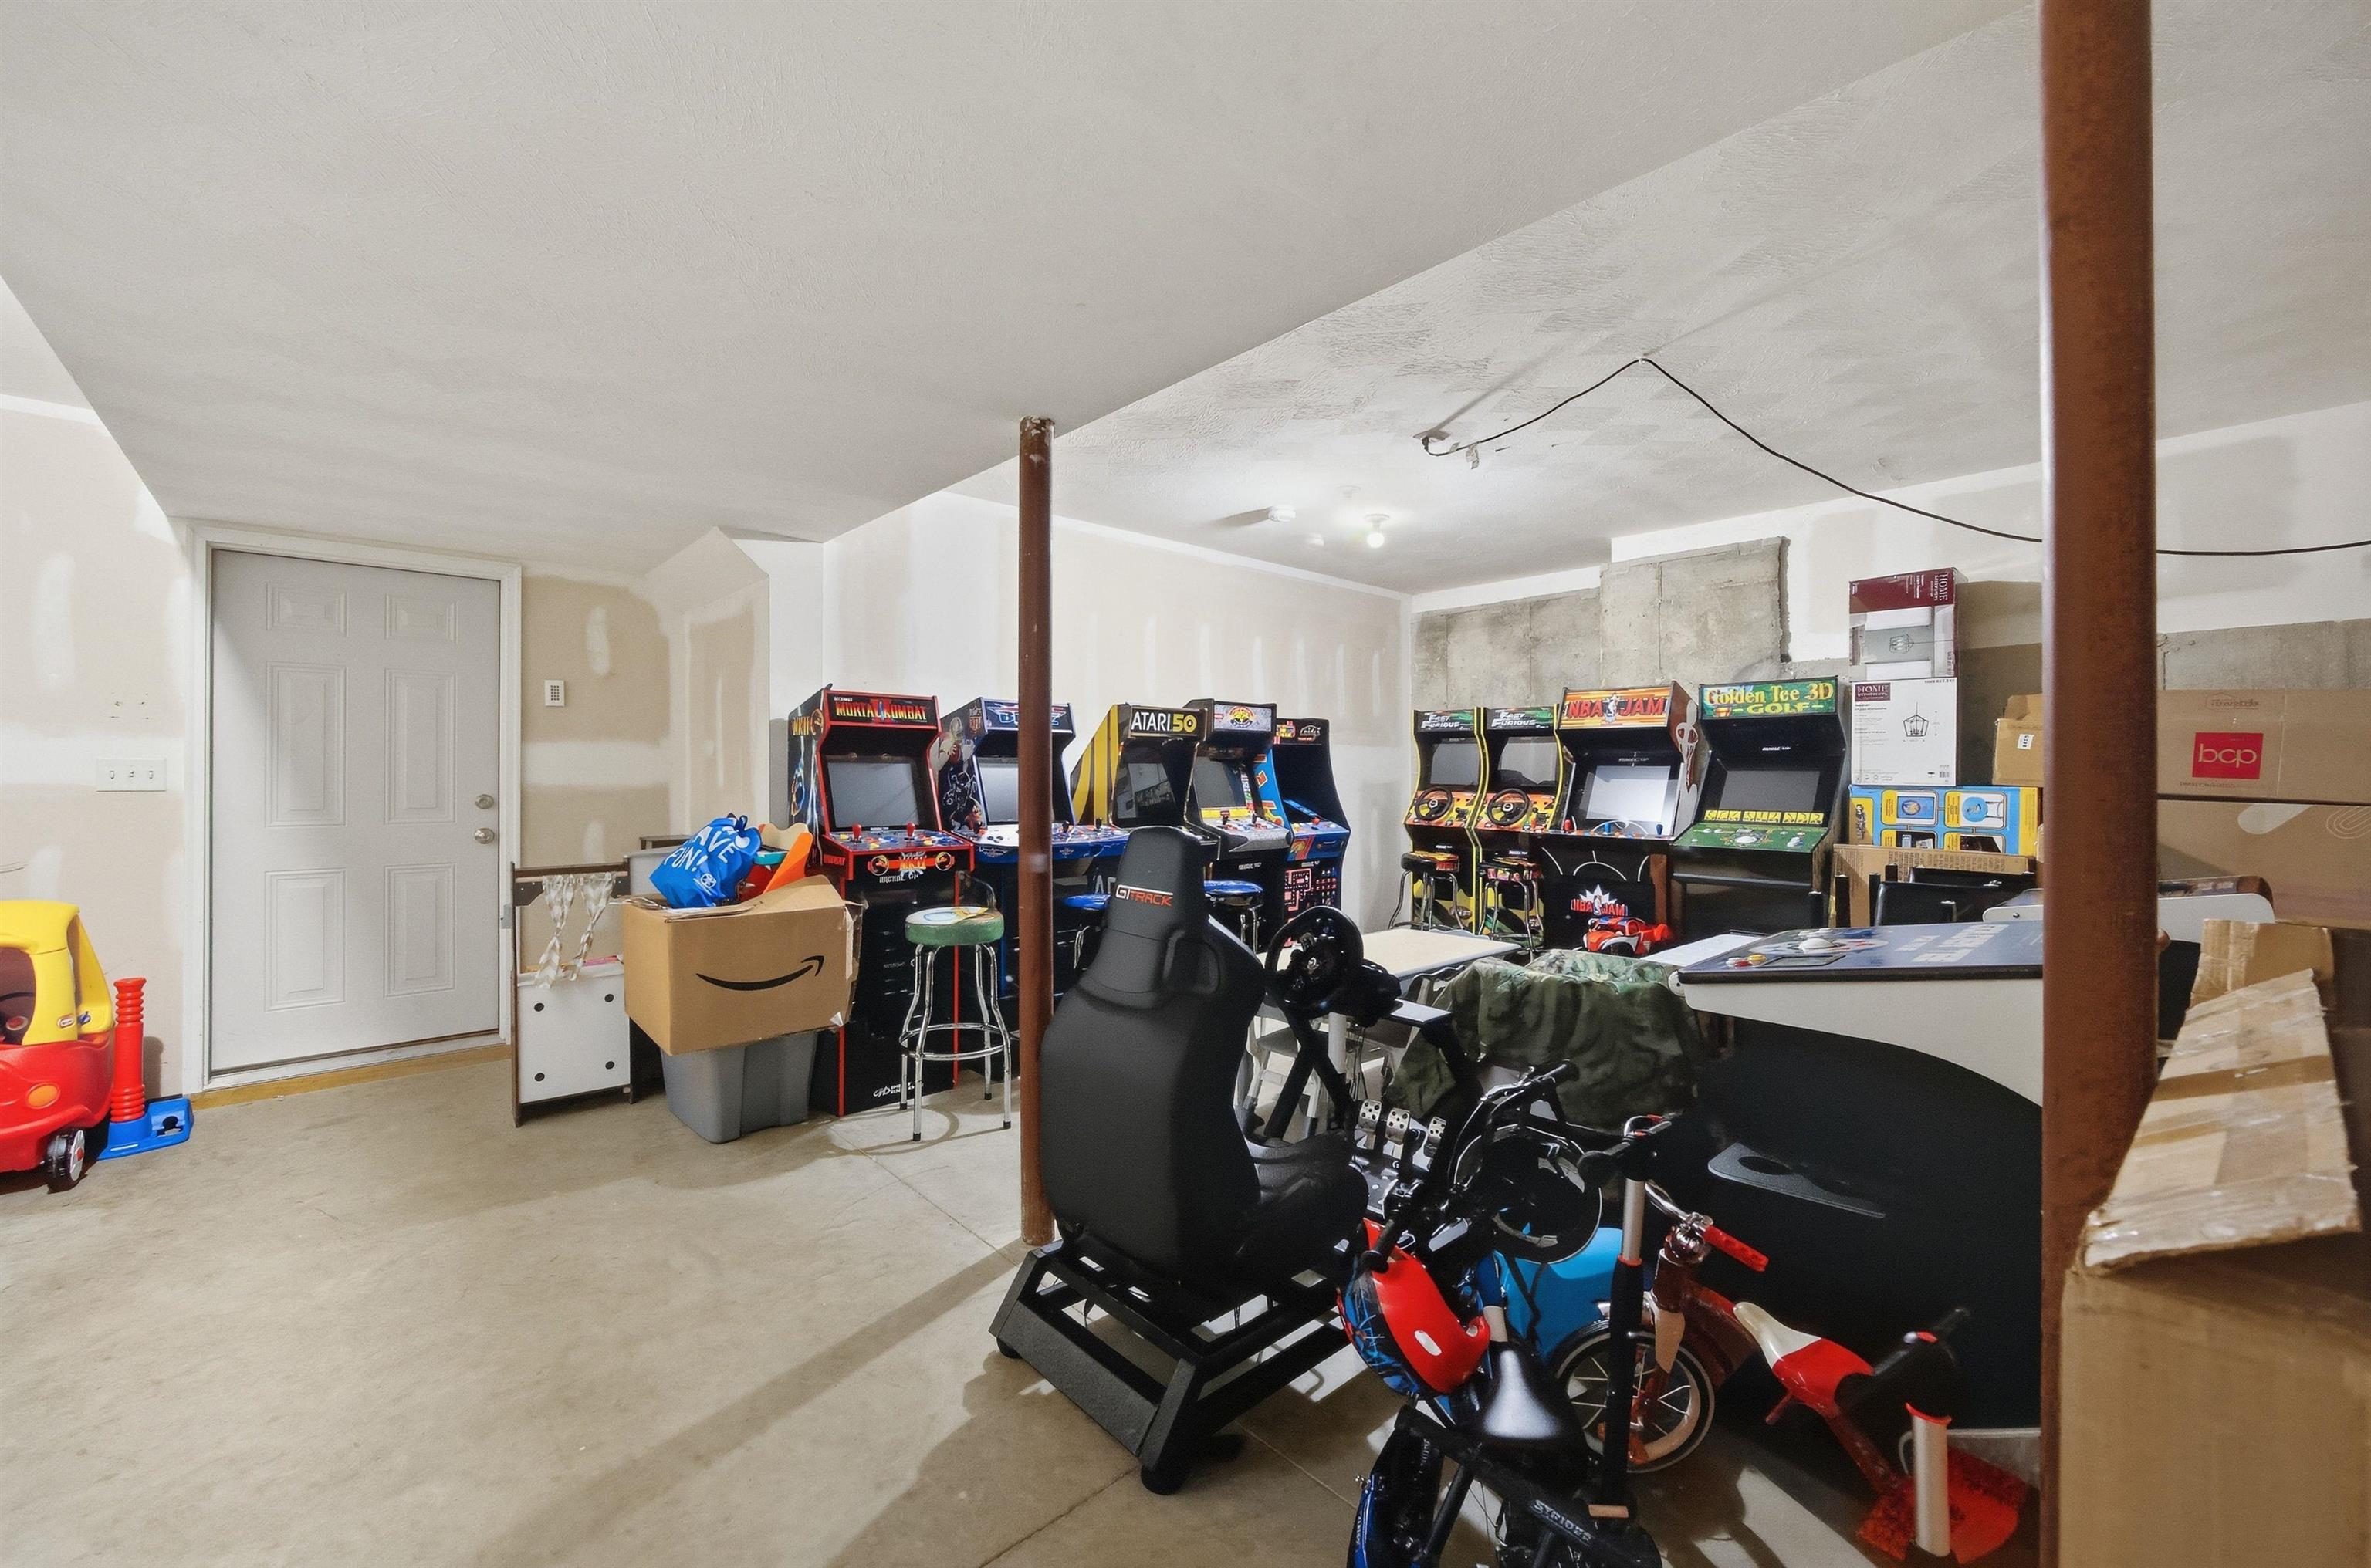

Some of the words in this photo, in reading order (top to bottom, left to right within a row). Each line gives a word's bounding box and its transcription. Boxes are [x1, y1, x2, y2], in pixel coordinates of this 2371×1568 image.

[1938, 572, 1949, 601] HOME
[1706, 685, 1766, 705] Golden
[1771, 684, 1800, 703] Tee
[1804, 682, 1834, 701] 3D
[1857, 684, 1889, 693] HOME
[836, 701, 880, 718] MORTAL
[883, 702, 928, 721] KOMBAT
[1568, 698, 1603, 718] NBA
[1619, 697, 1665, 716] JAM
[1747, 702, 1810, 715] GOLF
[1131, 711, 1171, 732] ATARI
[1173, 713, 1197, 732] 50
[2198, 743, 2257, 769] bcp
[664, 847, 708, 872] FUN!
